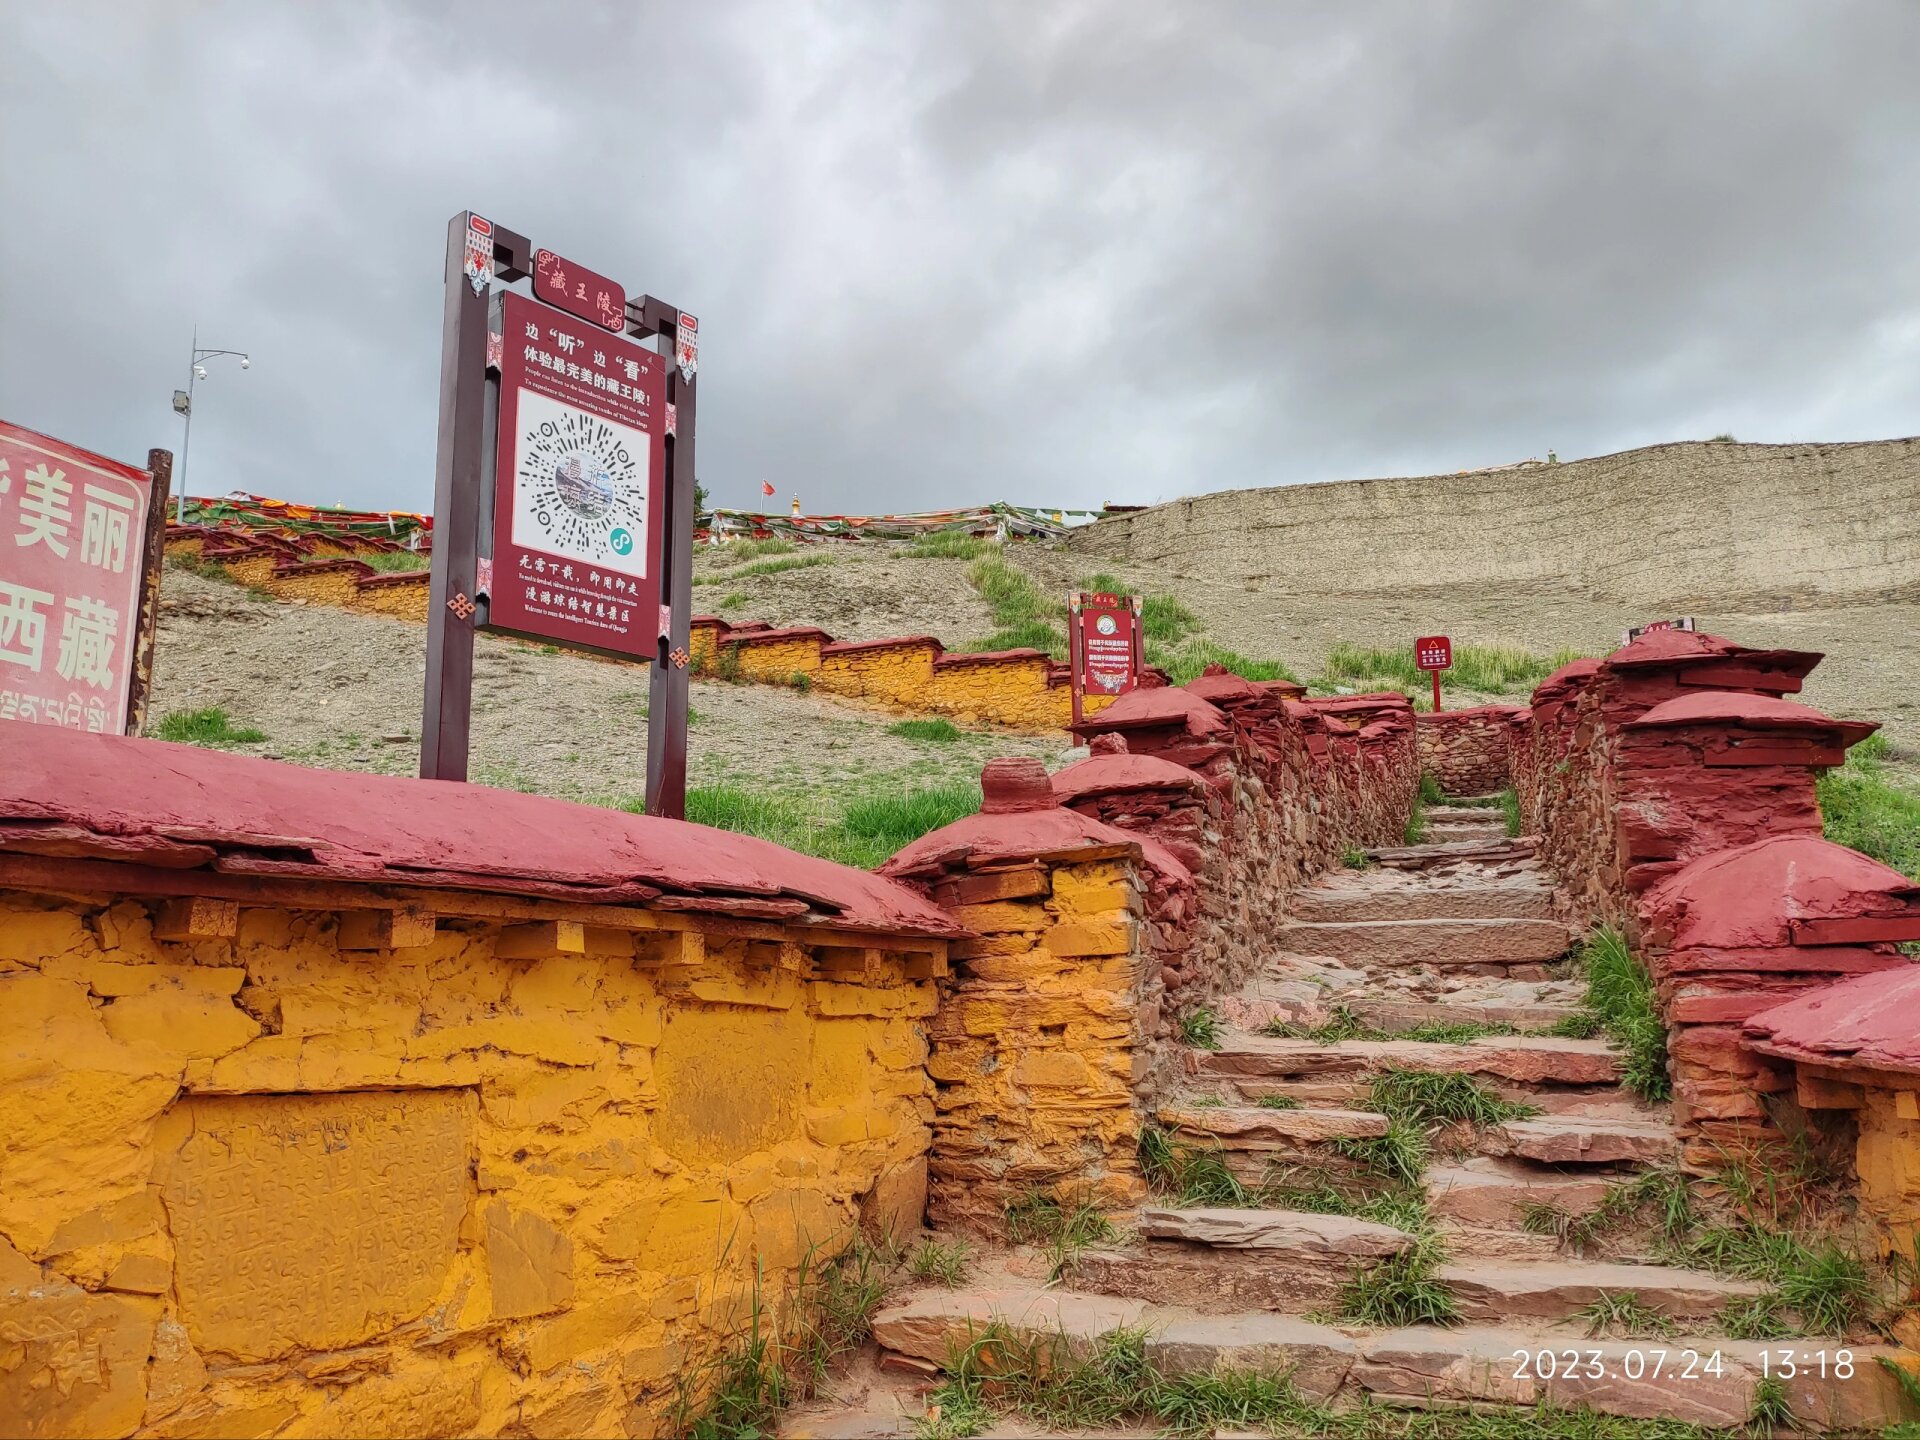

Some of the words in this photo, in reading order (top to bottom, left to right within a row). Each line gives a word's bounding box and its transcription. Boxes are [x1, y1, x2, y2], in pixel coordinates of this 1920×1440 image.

[550, 269, 613, 315] 藏王陵
[525, 321, 539, 340] 边
[549, 328, 585, 355] “听”
[594, 349, 606, 368] 边
[615, 355, 648, 381] “看”
[524, 366, 541, 377] People
[541, 373, 550, 381] can
[550, 376, 563, 386] listen
[569, 383, 577, 391] the
[606, 399, 618, 407] while
[524, 377, 531, 385] To
[532, 380, 557, 395] experience
[578, 398, 598, 411] amazing
[612, 410, 618, 418] of
[618, 413, 635, 425] Tibetan
[635, 420, 647, 429] kings
[0, 457, 135, 573] 美丽
[519, 554, 639, 597] 无需下载，即用即走
[524, 604, 542, 614] Welcome
[525, 586, 630, 623] 漫游琼结智慧景区
